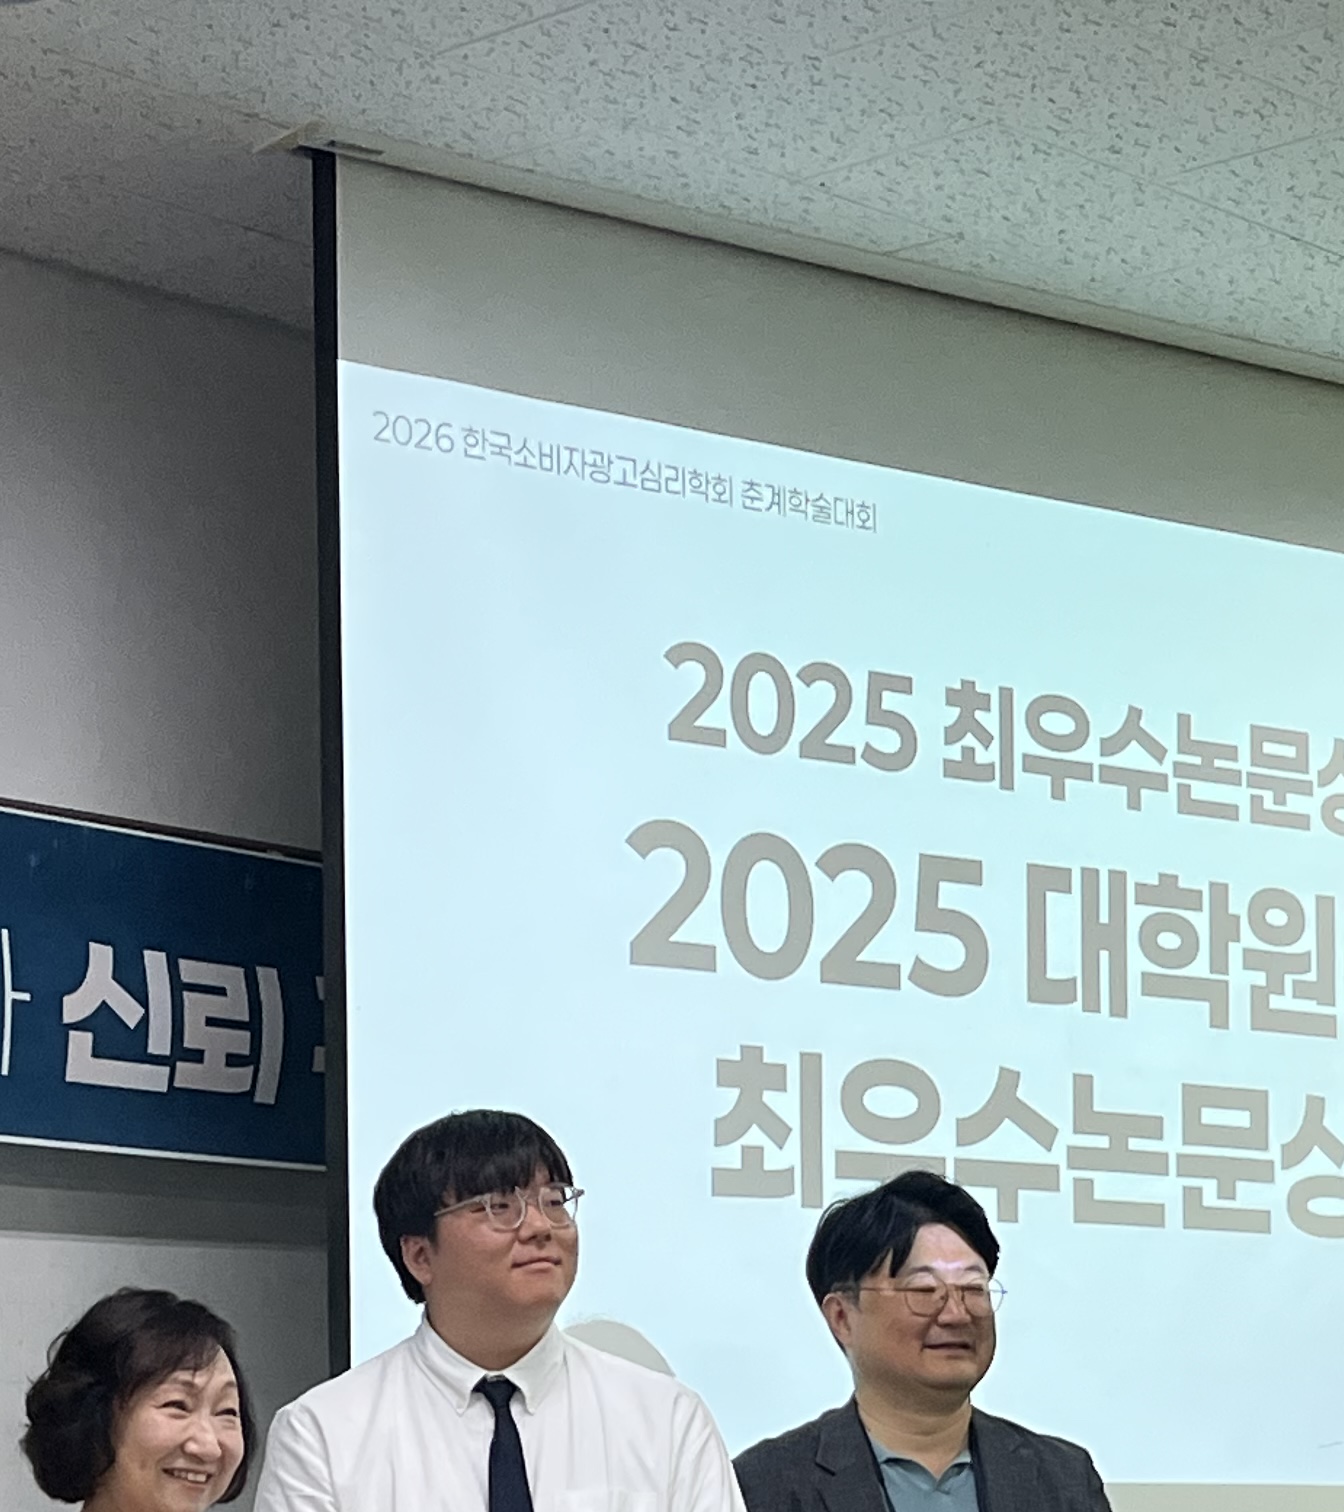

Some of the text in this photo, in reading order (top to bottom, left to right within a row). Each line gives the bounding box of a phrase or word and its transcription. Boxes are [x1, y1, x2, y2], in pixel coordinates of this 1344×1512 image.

[372, 411, 877, 533] 2026 한국소비자광고심리학회 춘계학술대회
[663, 641, 918, 772] 2025
[625, 819, 989, 998] 2025
[62, 942, 285, 1105] 신뢰
